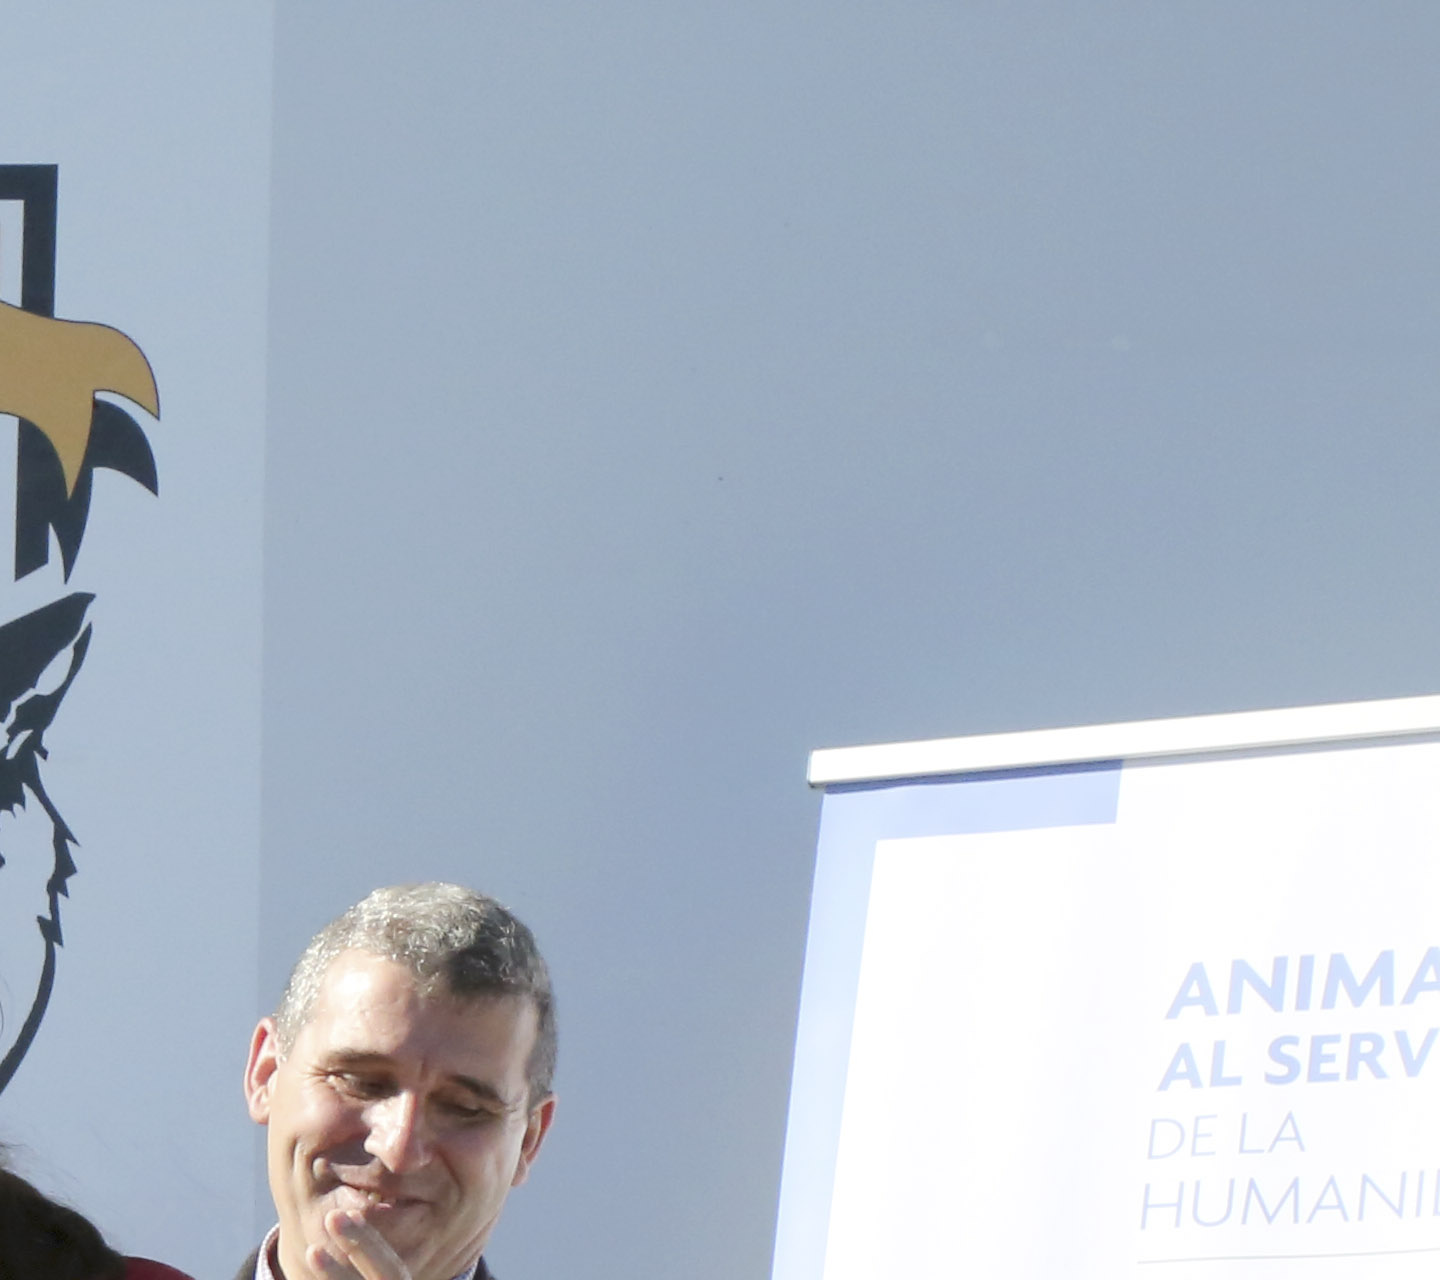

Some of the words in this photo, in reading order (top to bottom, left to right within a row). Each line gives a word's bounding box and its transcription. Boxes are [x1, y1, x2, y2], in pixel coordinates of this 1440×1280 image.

[1157, 1040, 1243, 1092] AL
[1264, 1027, 1440, 1085] SERV
[1146, 1114, 1218, 1161] DE
[1237, 1110, 1306, 1156] LA
[1140, 1169, 1440, 1231] HUMANI
